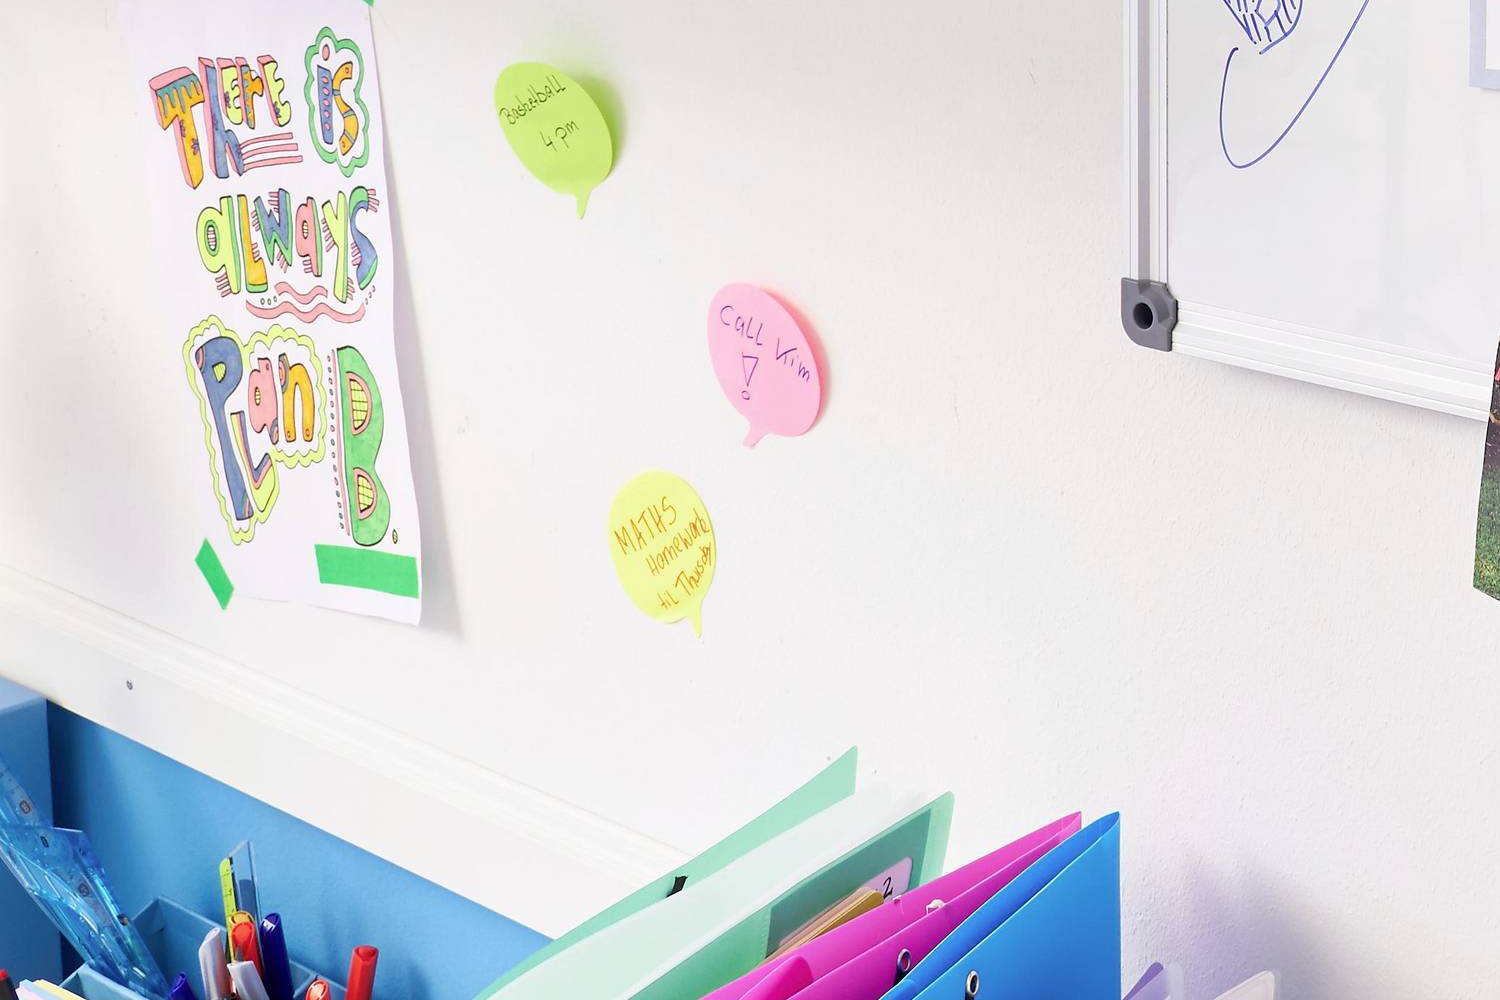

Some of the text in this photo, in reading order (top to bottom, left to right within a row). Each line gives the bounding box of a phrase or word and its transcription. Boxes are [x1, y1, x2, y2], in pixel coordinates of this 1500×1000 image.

[775, 336, 811, 382] Kim
[613, 496, 677, 556] MATHS
[882, 875, 894, 900] 2
